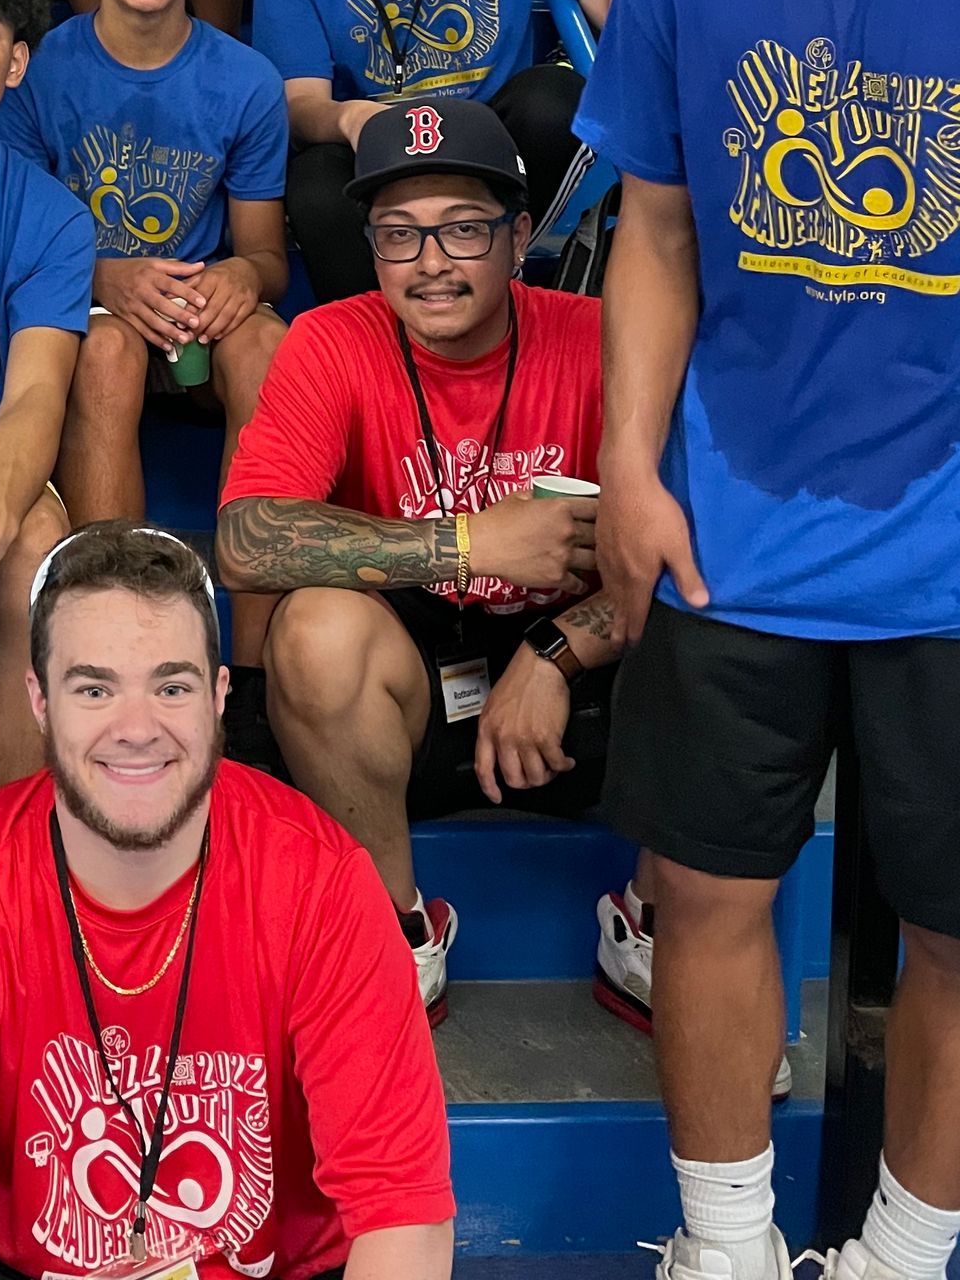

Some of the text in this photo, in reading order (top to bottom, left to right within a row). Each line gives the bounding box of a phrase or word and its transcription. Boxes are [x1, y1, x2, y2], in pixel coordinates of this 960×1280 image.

[726, 39, 862, 150] LOWELL
[405, 105, 445, 156] B
[808, 99, 922, 167] YOUTH
[742, 256, 800, 271] Building
[854, 269, 869, 279] of
[196, 1051, 267, 1097] 2022
